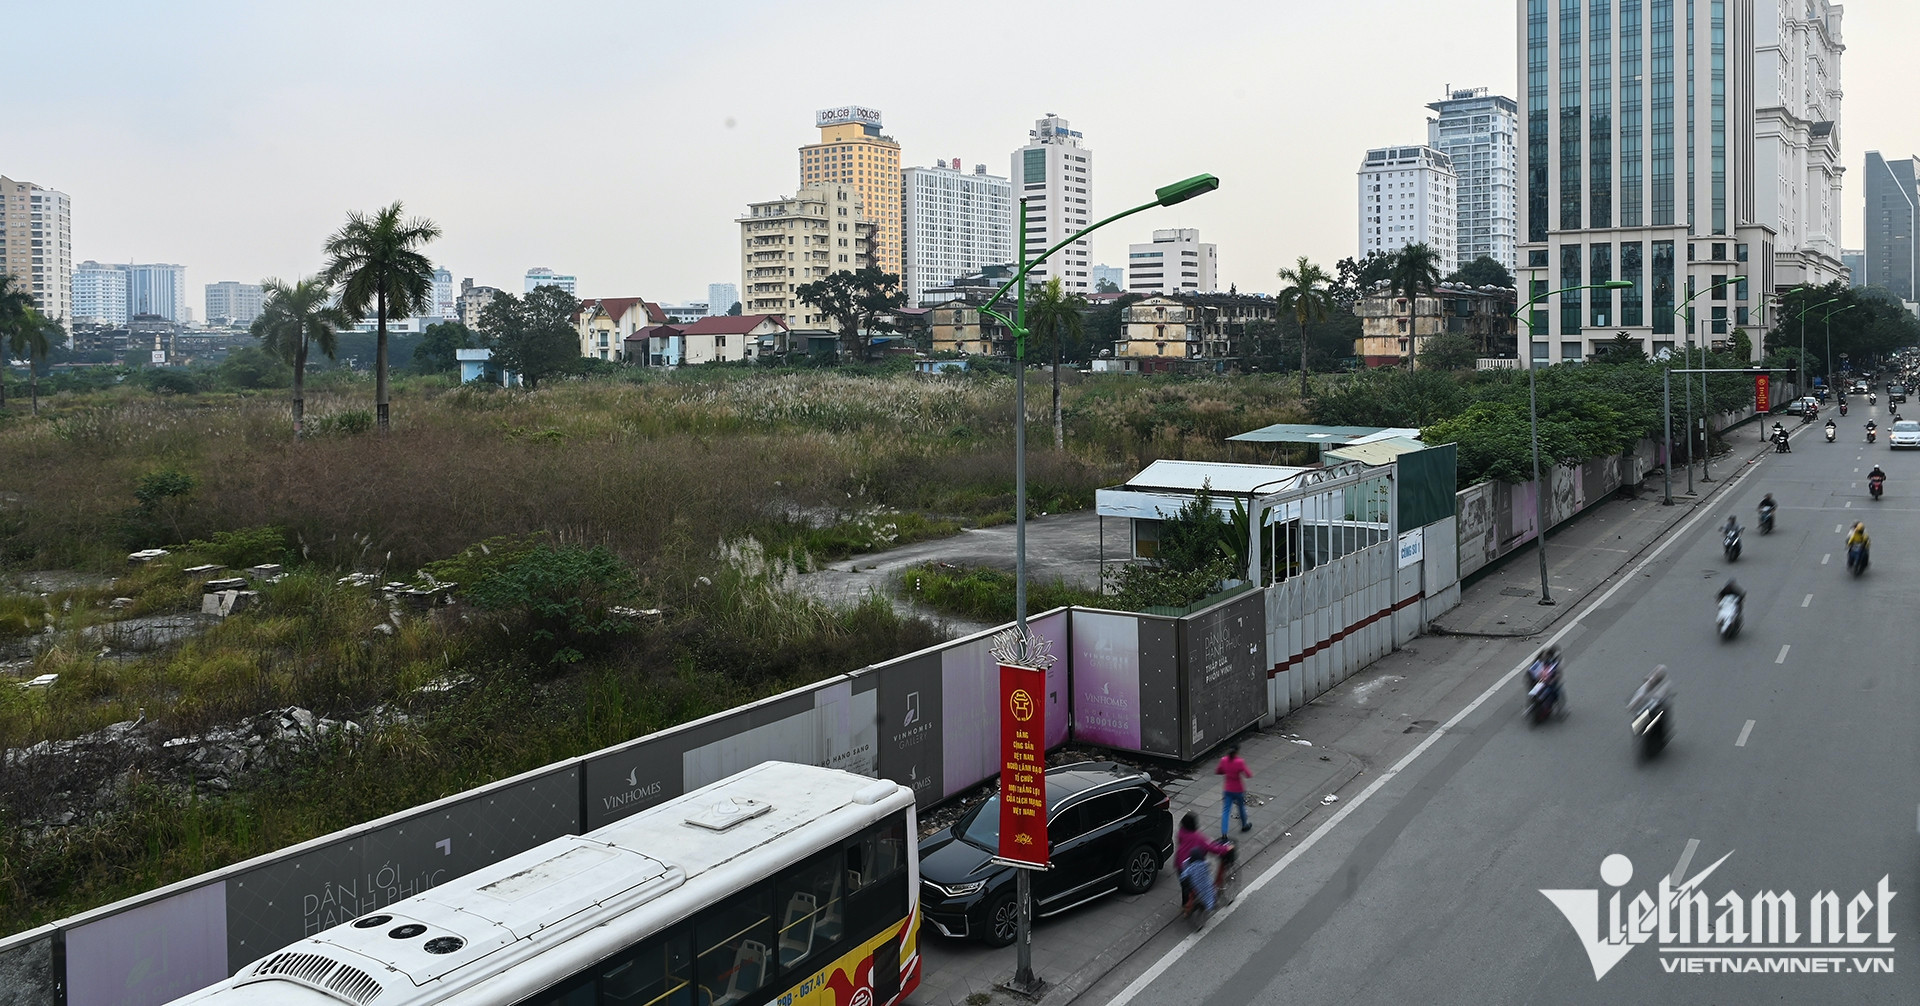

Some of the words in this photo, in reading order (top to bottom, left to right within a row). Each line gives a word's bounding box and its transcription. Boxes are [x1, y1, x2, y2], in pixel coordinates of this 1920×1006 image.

[1084, 693, 1128, 707] VINHOMES
[893, 722, 933, 741] VINHOMES
[1086, 716, 1128, 729] 18001036
[899, 732, 928, 750] GALLERY
[603, 781, 661, 810] VINHOMES
[304, 879, 357, 917] DẪN
[367, 860, 400, 894] LỐI
[799, 972, 825, 998] 057.41
